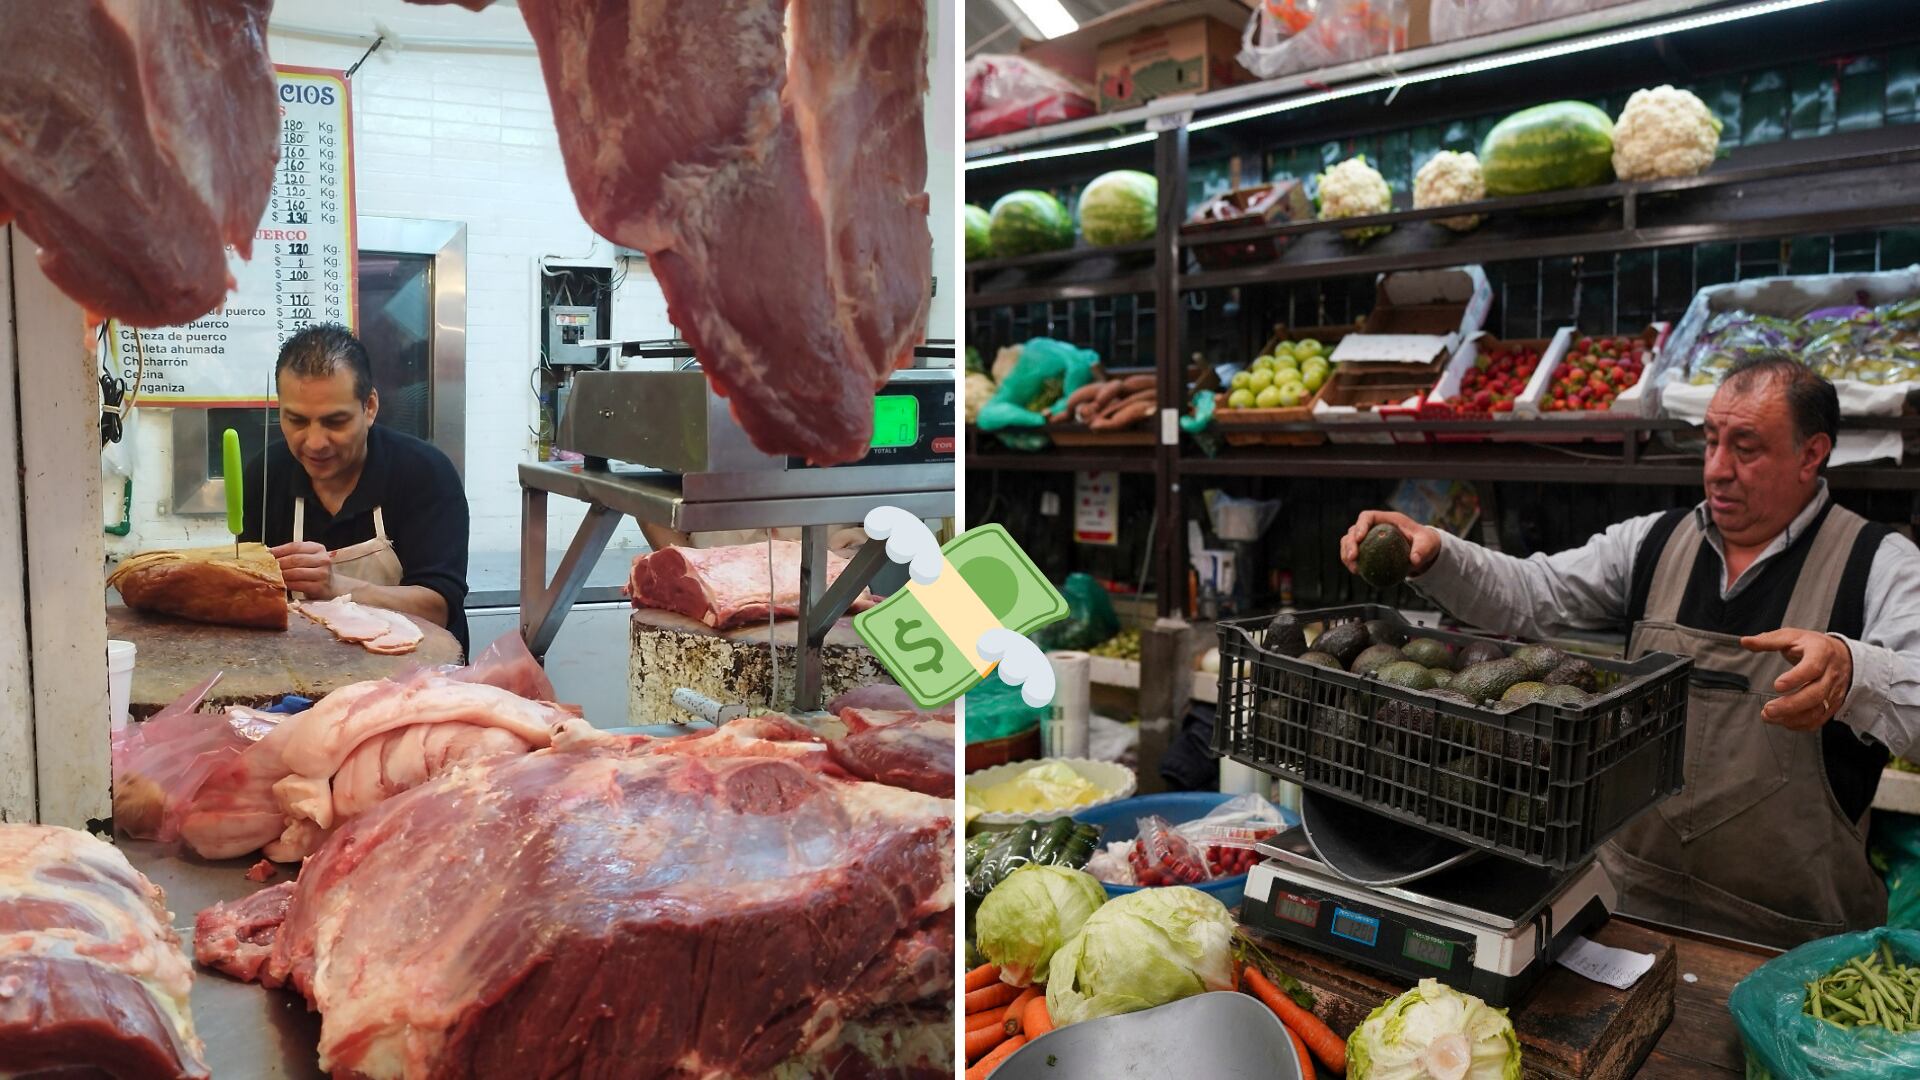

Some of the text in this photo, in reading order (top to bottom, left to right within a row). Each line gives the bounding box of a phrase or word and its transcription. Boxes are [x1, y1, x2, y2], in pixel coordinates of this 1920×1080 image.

[284, 119, 303, 131] 180
[284, 132, 304, 144] 180
[284, 147, 304, 158] 160
[284, 159, 304, 171] 160
[284, 173, 304, 184] 120
[286, 187, 305, 197] 120
[272, 198, 279, 209] $
[285, 199, 305, 211] 160
[272, 211, 279, 222] $
[286, 212, 308, 224] 130
[274, 243, 281, 254] $
[274, 256, 281, 267] $
[275, 269, 282, 279] $
[289, 270, 309, 281] 100
[275, 281, 282, 292] $
[276, 294, 283, 305] $
[290, 294, 310, 306] 110
[226, 308, 266, 318] puerco
[276, 307, 283, 318] $
[291, 307, 312, 319] 100
[188, 320, 229, 330] puerco
[168, 331, 182, 341] de
[186, 333, 227, 343] puerco
[170, 344, 225, 354] ahumada
[123, 356, 188, 366] Chcharrón
